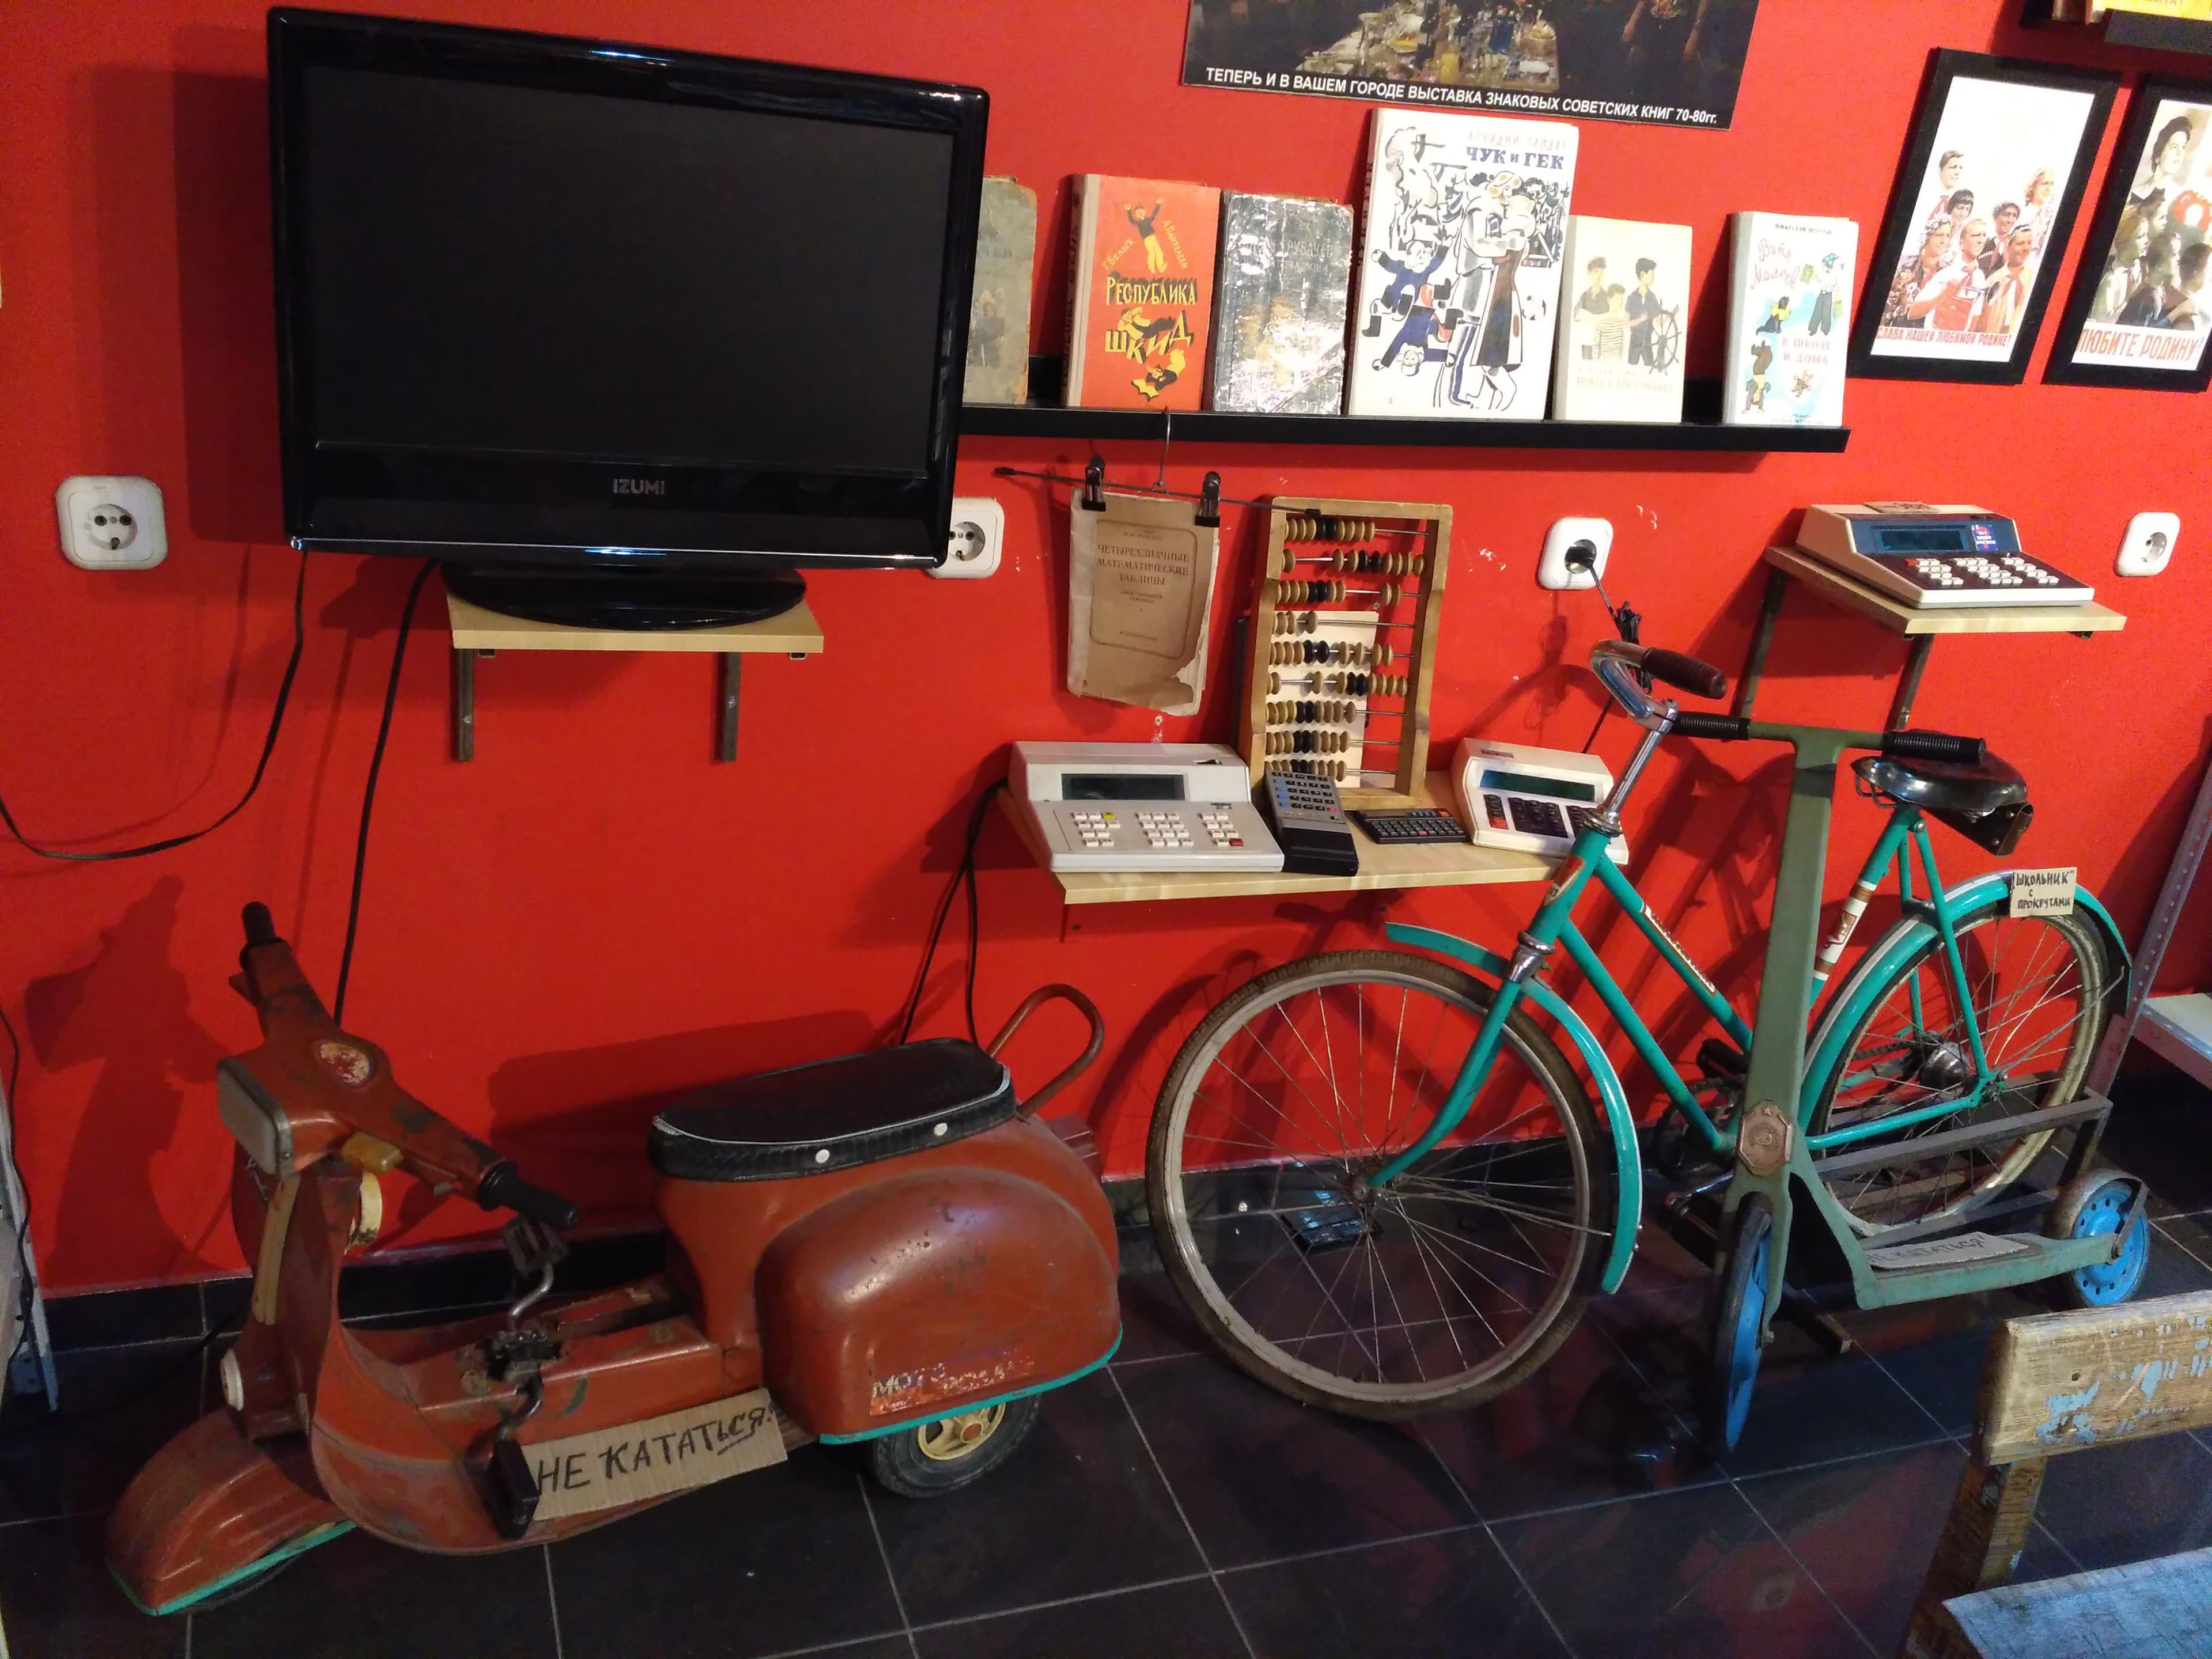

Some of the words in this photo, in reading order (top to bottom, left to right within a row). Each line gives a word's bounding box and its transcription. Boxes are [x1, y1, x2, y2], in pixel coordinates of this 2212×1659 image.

[1206, 67, 1262, 85] ТЕПЕРЬ
[1267, 73, 1276, 86] И
[1279, 74, 1290, 88] В
[1293, 75, 1347, 93] ВАШЕМ
[1350, 80, 1404, 99] ГОРОДЕ
[1408, 86, 1482, 105] ВЫСТАВКА
[1486, 92, 1559, 111] ЗНАКОВЫХ
[1563, 98, 1639, 117] СОВЕТСКИХ
[1641, 105, 1674, 120] КНИГ
[1676, 108, 1717, 124] 70-80гг.
[1466, 146, 1506, 164] ЧУК
[1523, 152, 1564, 170] ГЕК
[1105, 276, 1196, 305] РЕСПУБЛИКА
[1105, 310, 1193, 365] ШКИД
[1876, 327, 1904, 340] СЛАВА
[1905, 329, 1936, 342] НАШЕЙ
[1936, 331, 1976, 344] ЛЮБИМОЙ
[1978, 333, 2012, 347] РОДИНЕ!
[2077, 328, 2139, 357] ЛЮБИТЕ
[613, 478, 665, 495] IZUMI
[1097, 558, 1189, 577] МАТЕМАТИЧЕСКИЕ
[1118, 573, 1165, 586] ТАБЛИЦЫ
[2018, 897, 2070, 910] ПРОКРУТАМИ
[537, 1453, 591, 1495] НЕ
